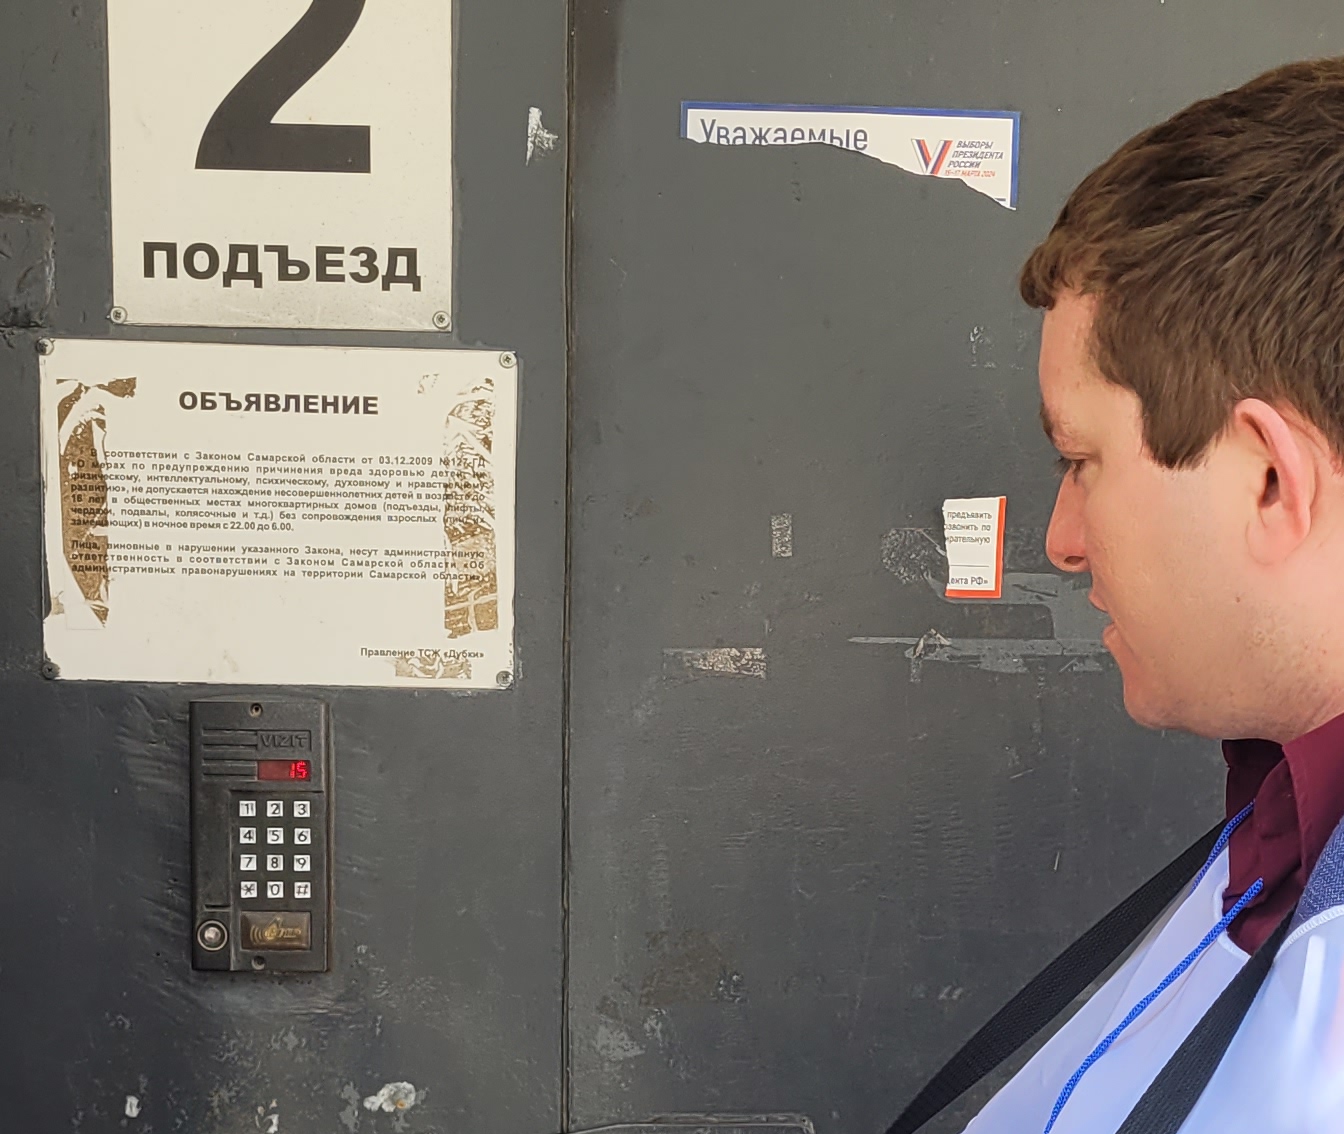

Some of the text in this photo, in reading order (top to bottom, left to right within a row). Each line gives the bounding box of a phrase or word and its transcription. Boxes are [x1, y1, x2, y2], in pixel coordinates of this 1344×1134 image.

[195, 0, 371, 173] 2
[700, 118, 869, 151] Уважаемые
[956, 140, 994, 149] ВЫБОРЫ
[951, 150, 1004, 160] ПРЕЗИДЕНТА
[947, 160, 982, 168] РОССИИ
[142, 241, 422, 292] ПОДЪЕЗД
[178, 391, 379, 415] ОБЪЯВЛЕНИЕ
[105, 451, 178, 459] соответствии
[195, 452, 241, 460] Законом
[247, 453, 306, 463] Самарской
[312, 455, 356, 463] области
[378, 456, 433, 465] 03.12.2009
[91, 462, 126, 471] мерах
[132, 463, 145, 471] по
[152, 463, 250, 473] предупреждению
[256, 466, 323, 475] причинения
[329, 468, 363, 477] вреда
[368, 469, 425, 478] здоровью
[146, 475, 251, 485] интеллектуальному,
[256, 477, 329, 487] психическому,
[334, 480, 390, 488] духовному
[146, 487, 209, 496] допускается
[212, 488, 272, 497] нахождение
[274, 489, 382, 499] несовершеннолетних
[385, 491, 414, 500] детей
[123, 496, 201, 506] общественных
[206, 499, 242, 507] местах
[247, 500, 339, 510] многоквартирных
[344, 502, 378, 510] домов
[175, 510, 236, 518] колясочные
[279, 511, 296, 519] без
[301, 513, 382, 522] сопровождения
[387, 515, 437, 523] взрослых
[152, 521, 188, 529] ночное
[190, 522, 221, 531] время
[229, 520, 255, 529] 22.00
[257, 522, 270, 531] до
[107, 542, 160, 550] виновные
[178, 544, 236, 552] нарушении
[241, 545, 299, 554] указанного
[304, 546, 344, 556] Закона,
[349, 548, 379, 557] несут
[384, 549, 485, 559] административную
[71, 553, 170, 562] ответственность
[189, 556, 268, 564] соответствии
[286, 556, 335, 566] Законом
[341, 558, 404, 568] Самарской
[410, 559, 457, 568] области
[71, 565, 175, 574] административных
[181, 567, 278, 577] правонарушениях
[301, 570, 364, 578] территории
[369, 569, 427, 580] Самарской
[949, 576, 969, 585] ента
[360, 648, 484, 661] Правление ТСЖ «Дубки»
[259, 734, 308, 748] VIZIT
[244, 803, 307, 816] 1 2 3
[243, 829, 308, 842] 4 5 6
[244, 857, 307, 869] 7 8 9
